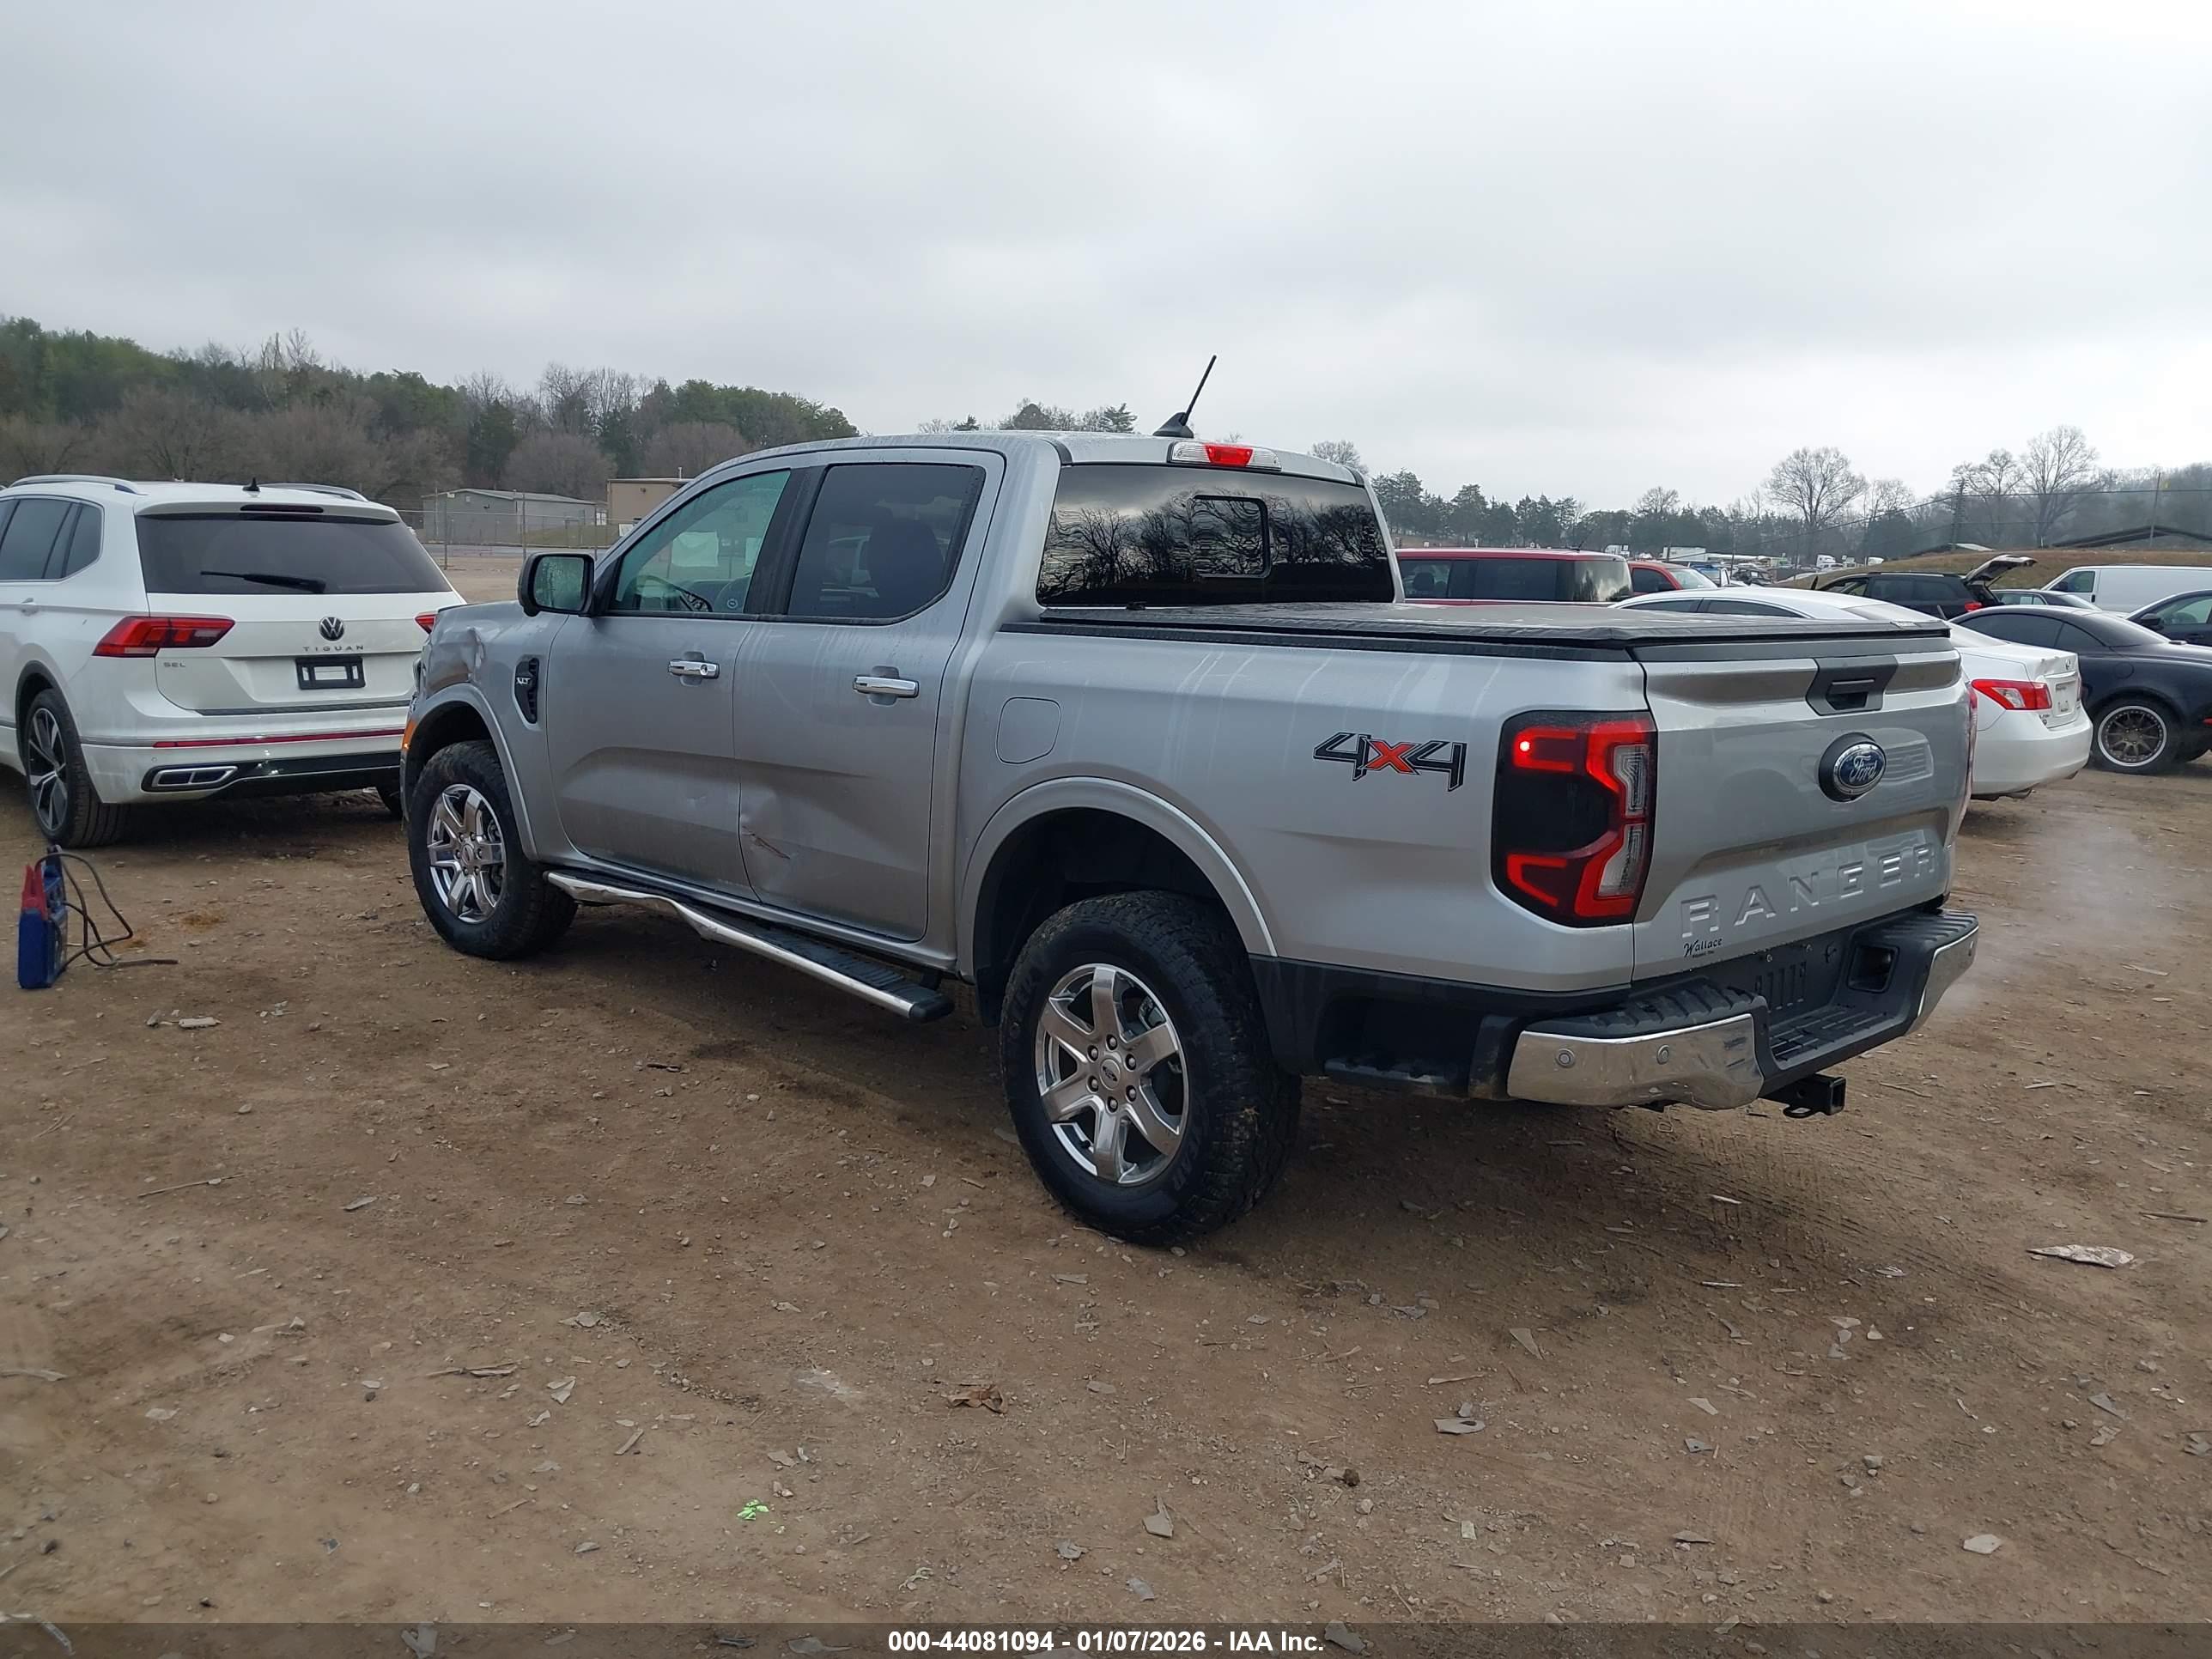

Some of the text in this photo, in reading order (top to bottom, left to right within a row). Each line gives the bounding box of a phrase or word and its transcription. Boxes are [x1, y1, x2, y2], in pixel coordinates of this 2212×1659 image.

[1849, 755, 1878, 783] Ford
[1680, 842, 1936, 939] RANGER
[1683, 938, 1723, 957] Wallace
